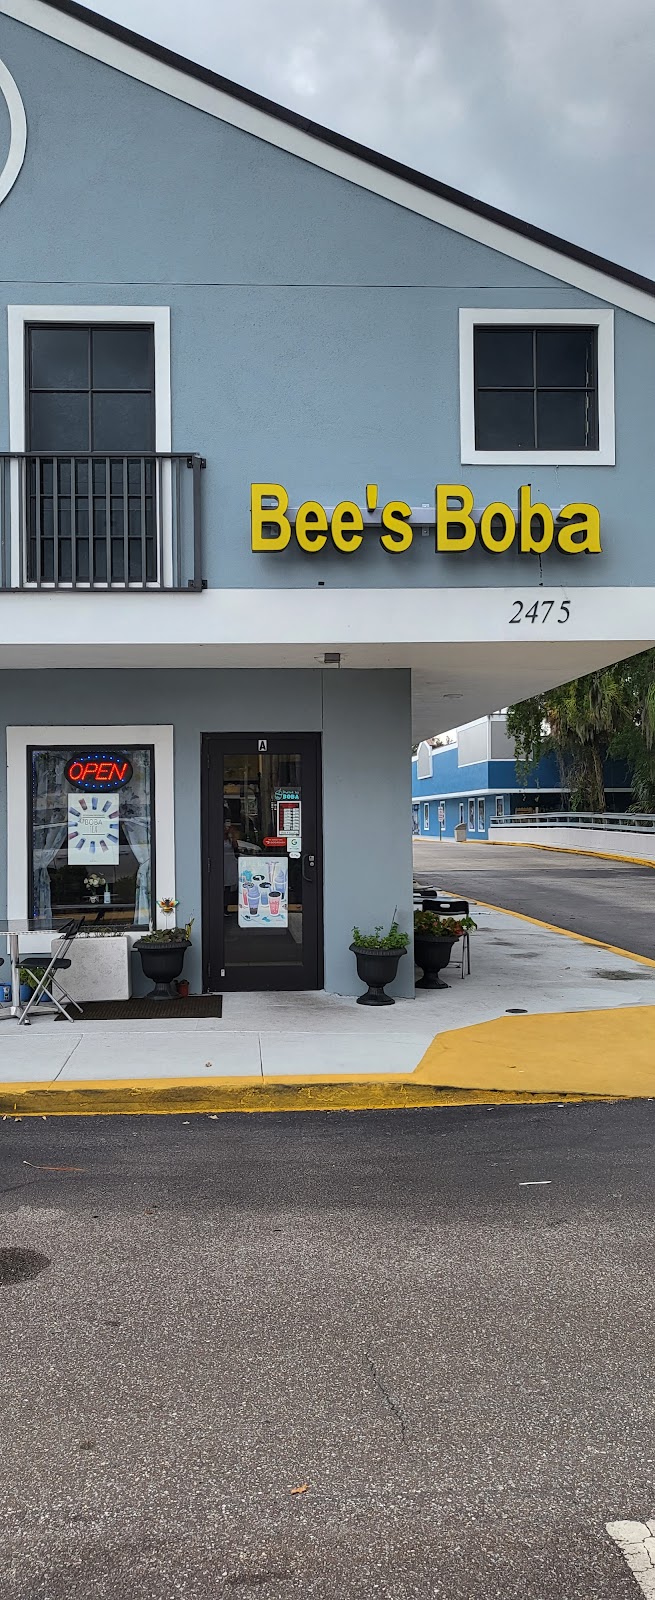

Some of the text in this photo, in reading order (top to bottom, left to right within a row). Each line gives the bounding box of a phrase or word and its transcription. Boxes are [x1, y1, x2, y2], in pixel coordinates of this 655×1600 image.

[251, 483, 603, 555] Bee's Boba
[508, 600, 572, 624] 2475
[259, 740, 266, 751] A
[68, 763, 128, 781] OPEN
